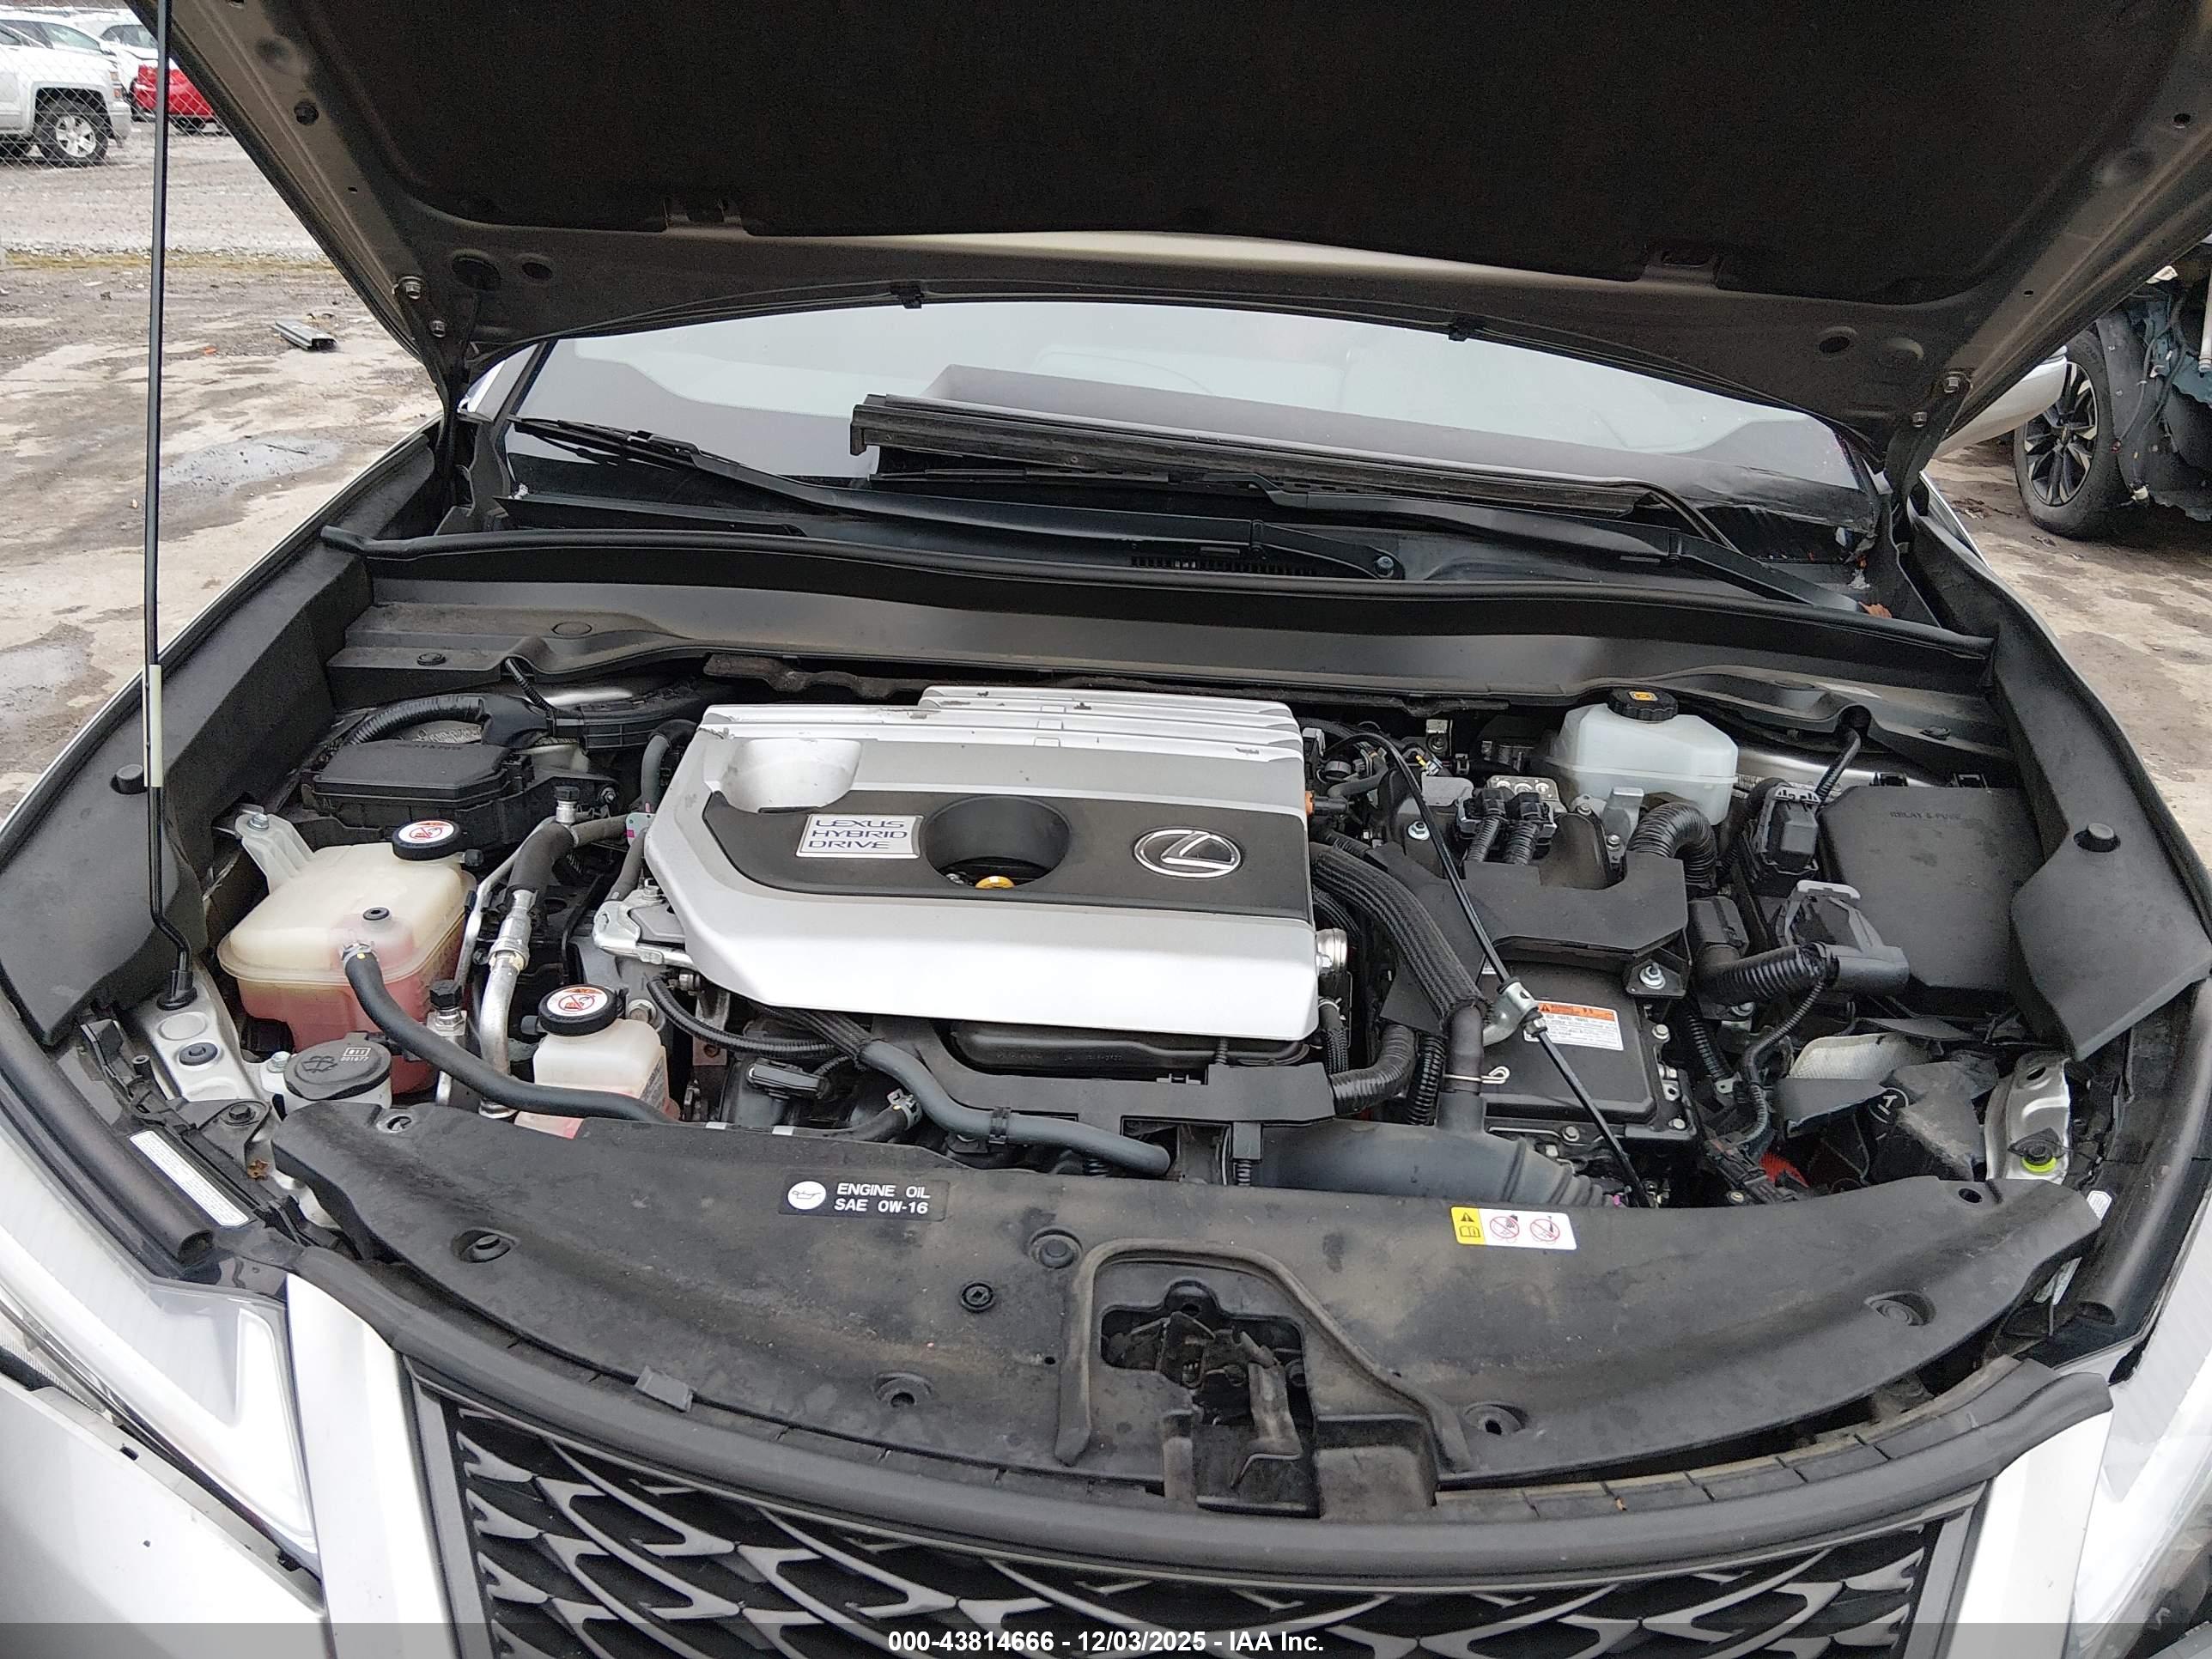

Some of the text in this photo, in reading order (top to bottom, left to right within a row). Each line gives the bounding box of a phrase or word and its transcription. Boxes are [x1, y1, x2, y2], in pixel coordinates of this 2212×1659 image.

[815, 819, 905, 829] LEXUS
[811, 830, 908, 839] HYBRID
[808, 840, 890, 849] DRIVE
[836, 1182, 932, 1199] ENGINE OIL
[834, 1198, 929, 1214] SAE 0W-16
